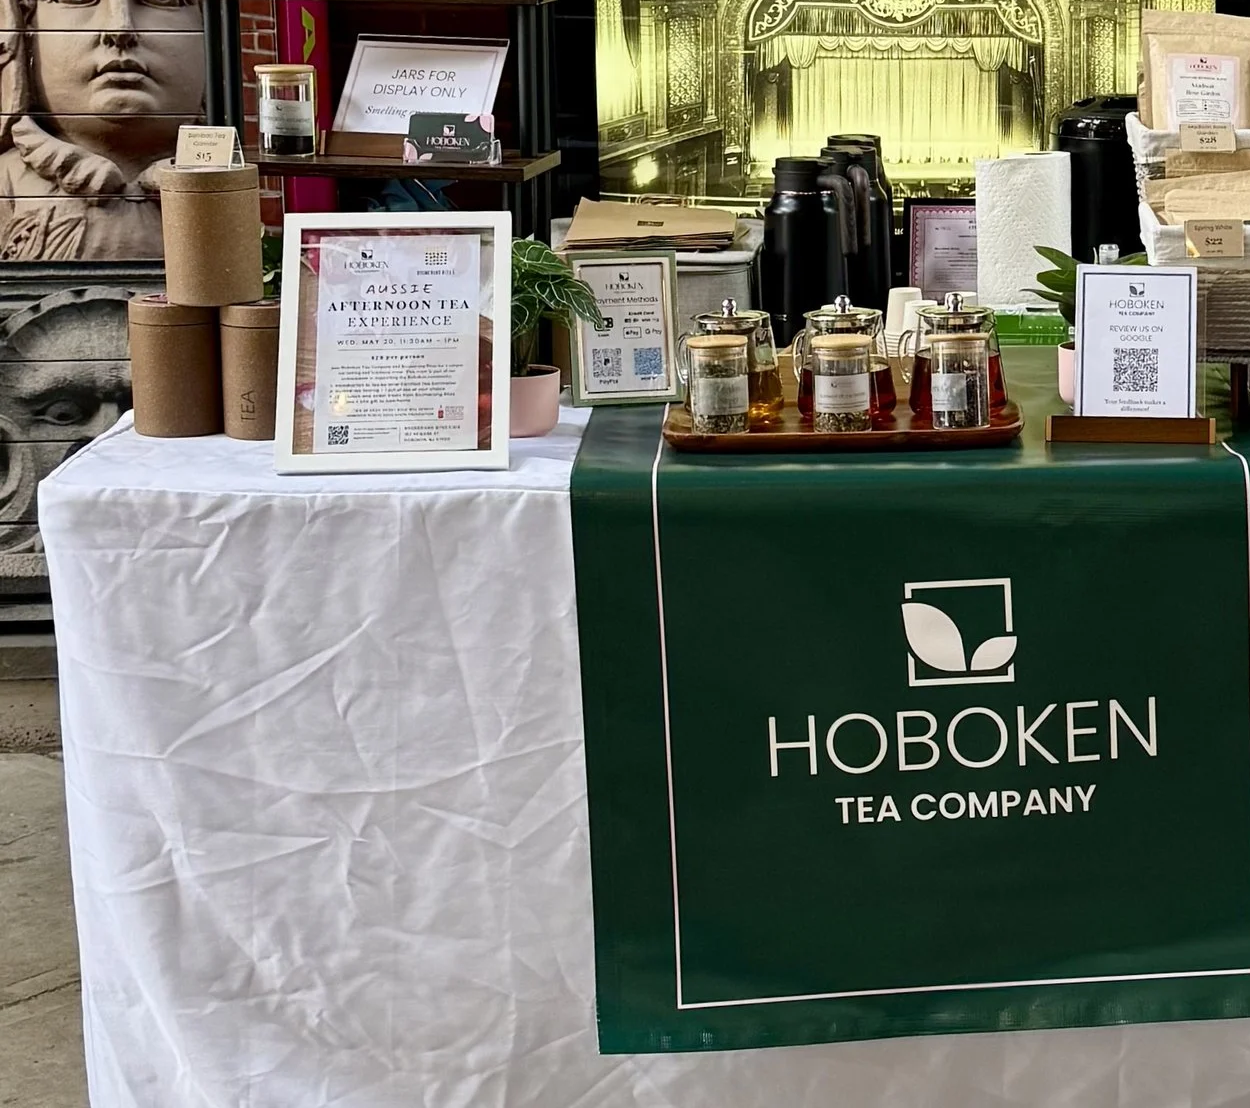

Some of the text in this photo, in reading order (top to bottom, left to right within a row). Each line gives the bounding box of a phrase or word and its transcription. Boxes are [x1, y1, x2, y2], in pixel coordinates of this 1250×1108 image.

[392, 69, 456, 82] JARS FOR
[373, 83, 467, 99] DISPLAY ONLY
[365, 105, 407, 119] Smelling
[426, 136, 470, 147] HOBOKEN
[196, 152, 212, 163] $15
[366, 283, 433, 294] AUSSIE
[328, 299, 470, 312] AFTERNOON TEA
[1109, 300, 1164, 309] HOBOKEN
[348, 316, 452, 328] EXPERIENCE
[241, 390, 256, 421] TEA
[767, 697, 1158, 777] HOBOKEN
[835, 785, 1097, 824] TEA COMPANY
